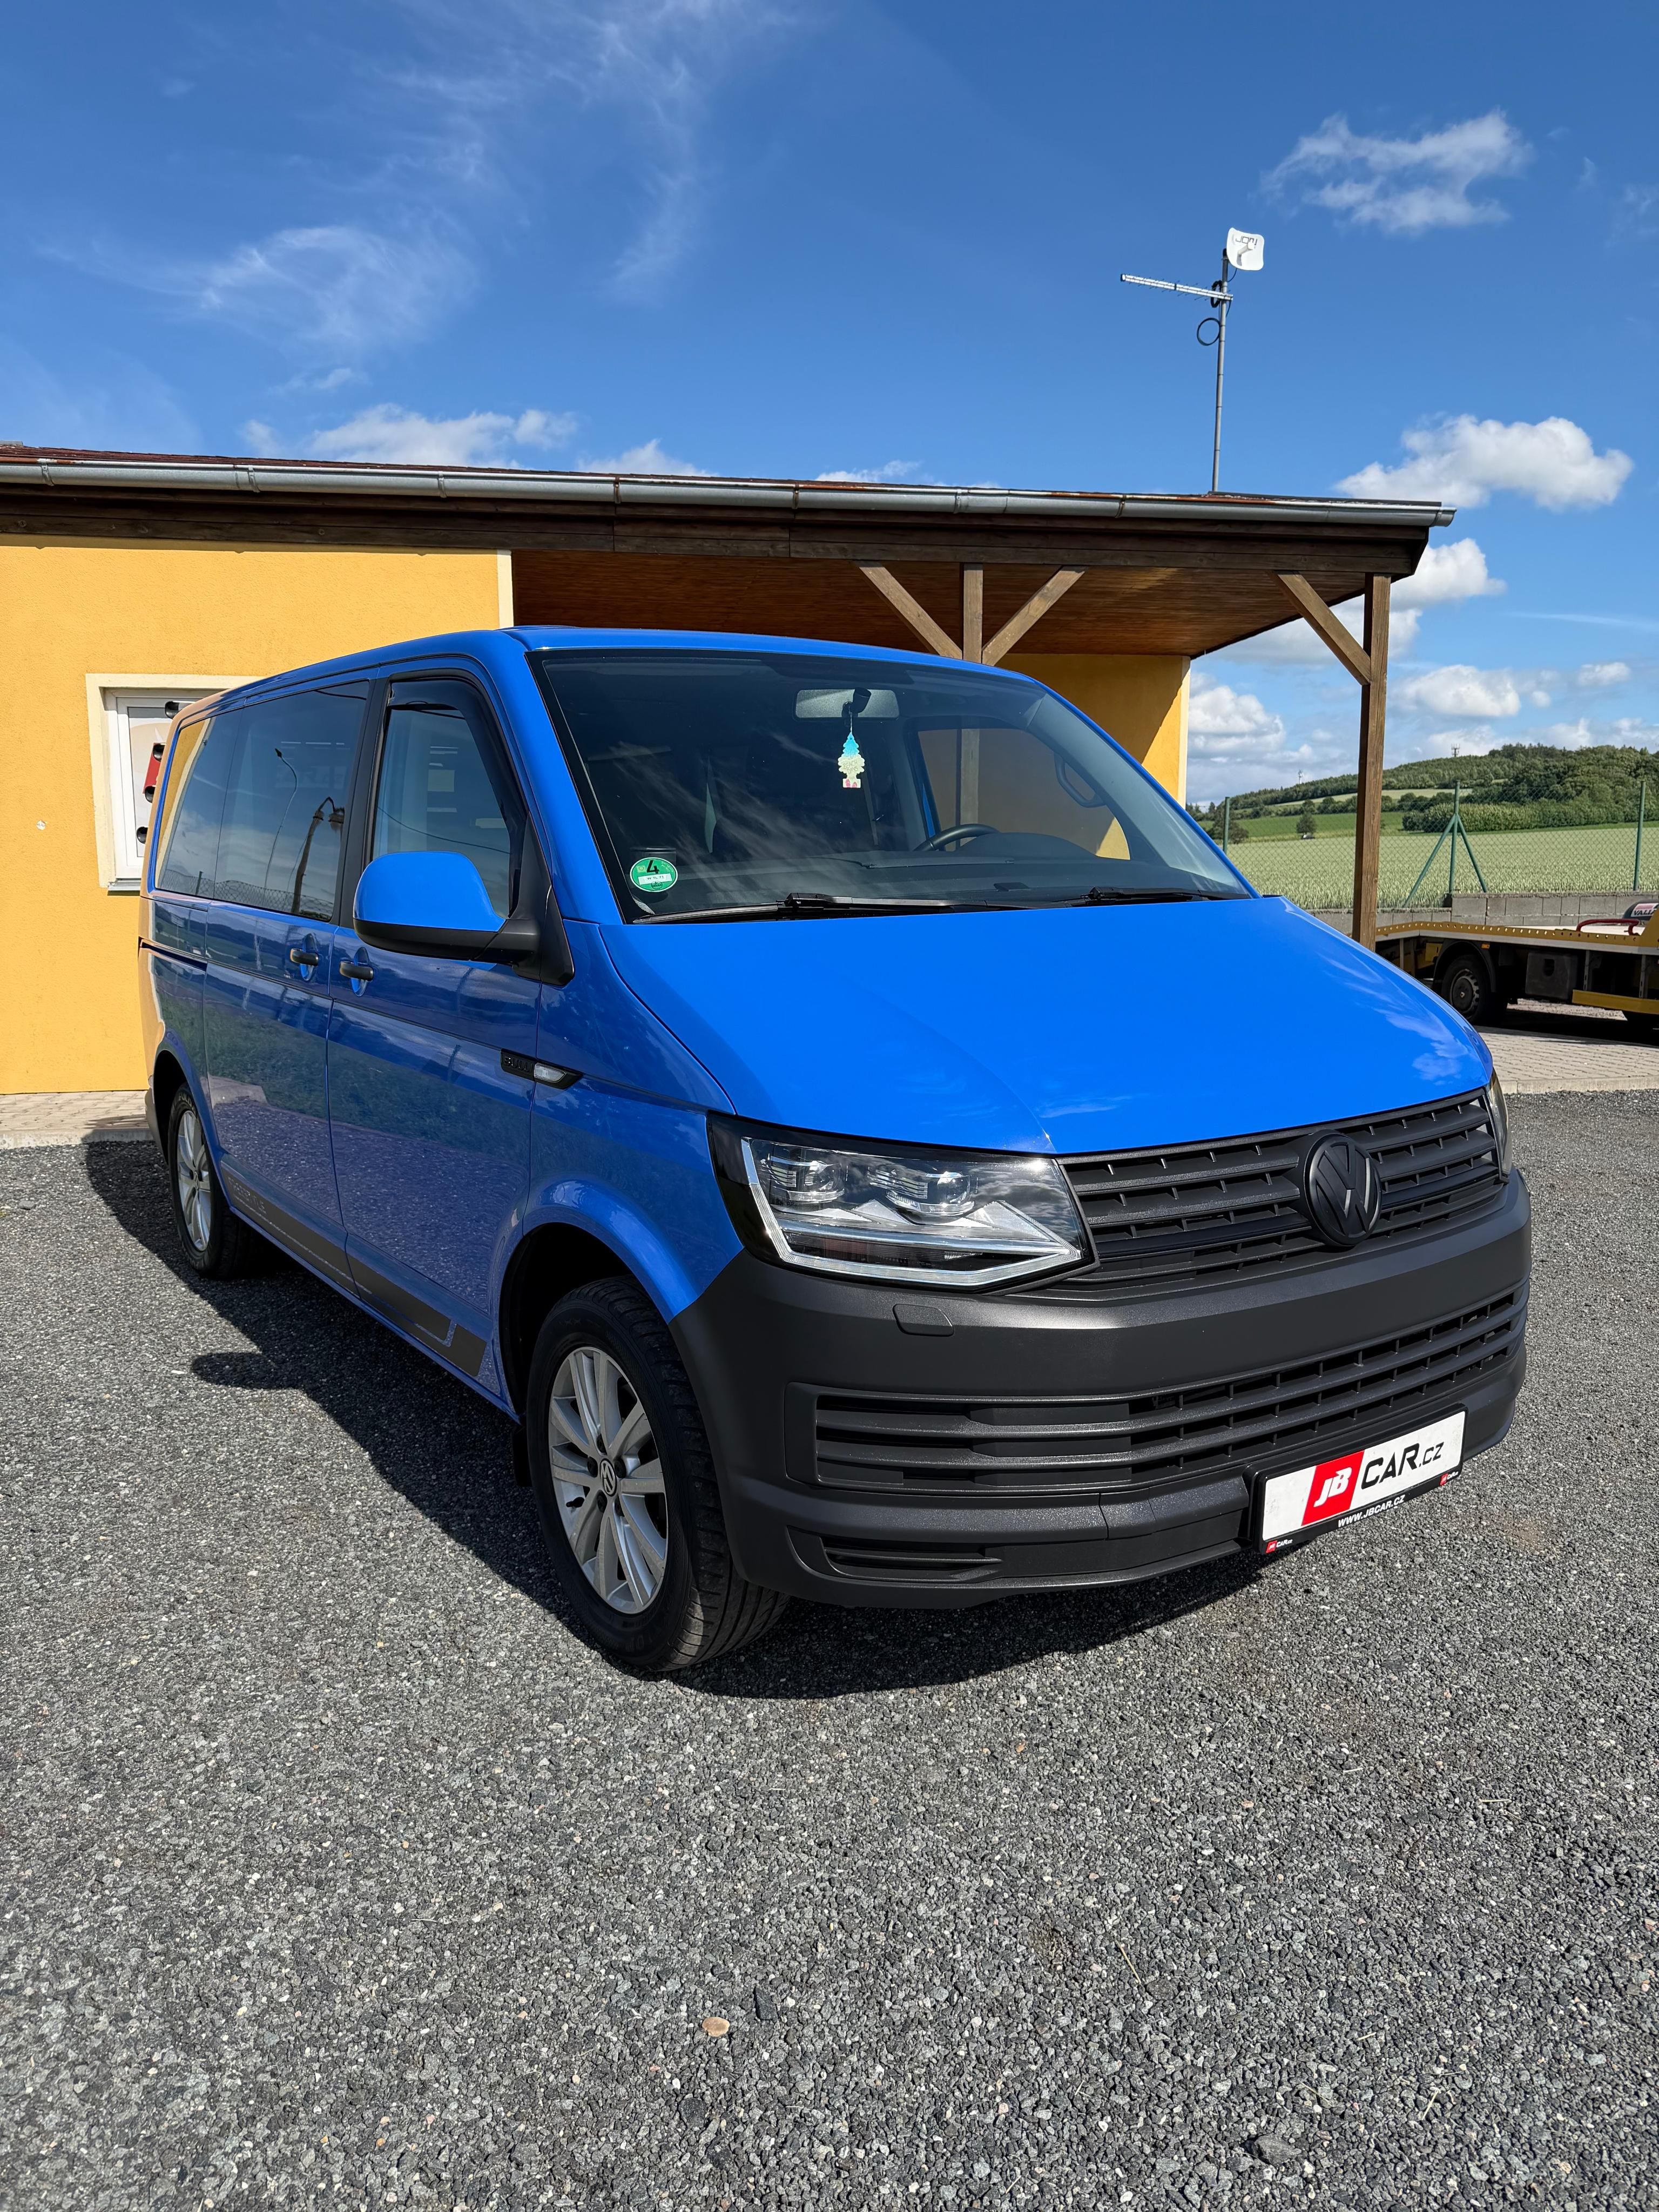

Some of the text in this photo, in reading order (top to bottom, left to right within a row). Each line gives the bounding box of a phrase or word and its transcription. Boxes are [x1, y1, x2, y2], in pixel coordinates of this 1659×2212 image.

[646, 859, 660, 874] 4
[1313, 1467, 1352, 1508] JB
[1338, 1494, 1405, 1528] WWW.JBCAR.CZ
